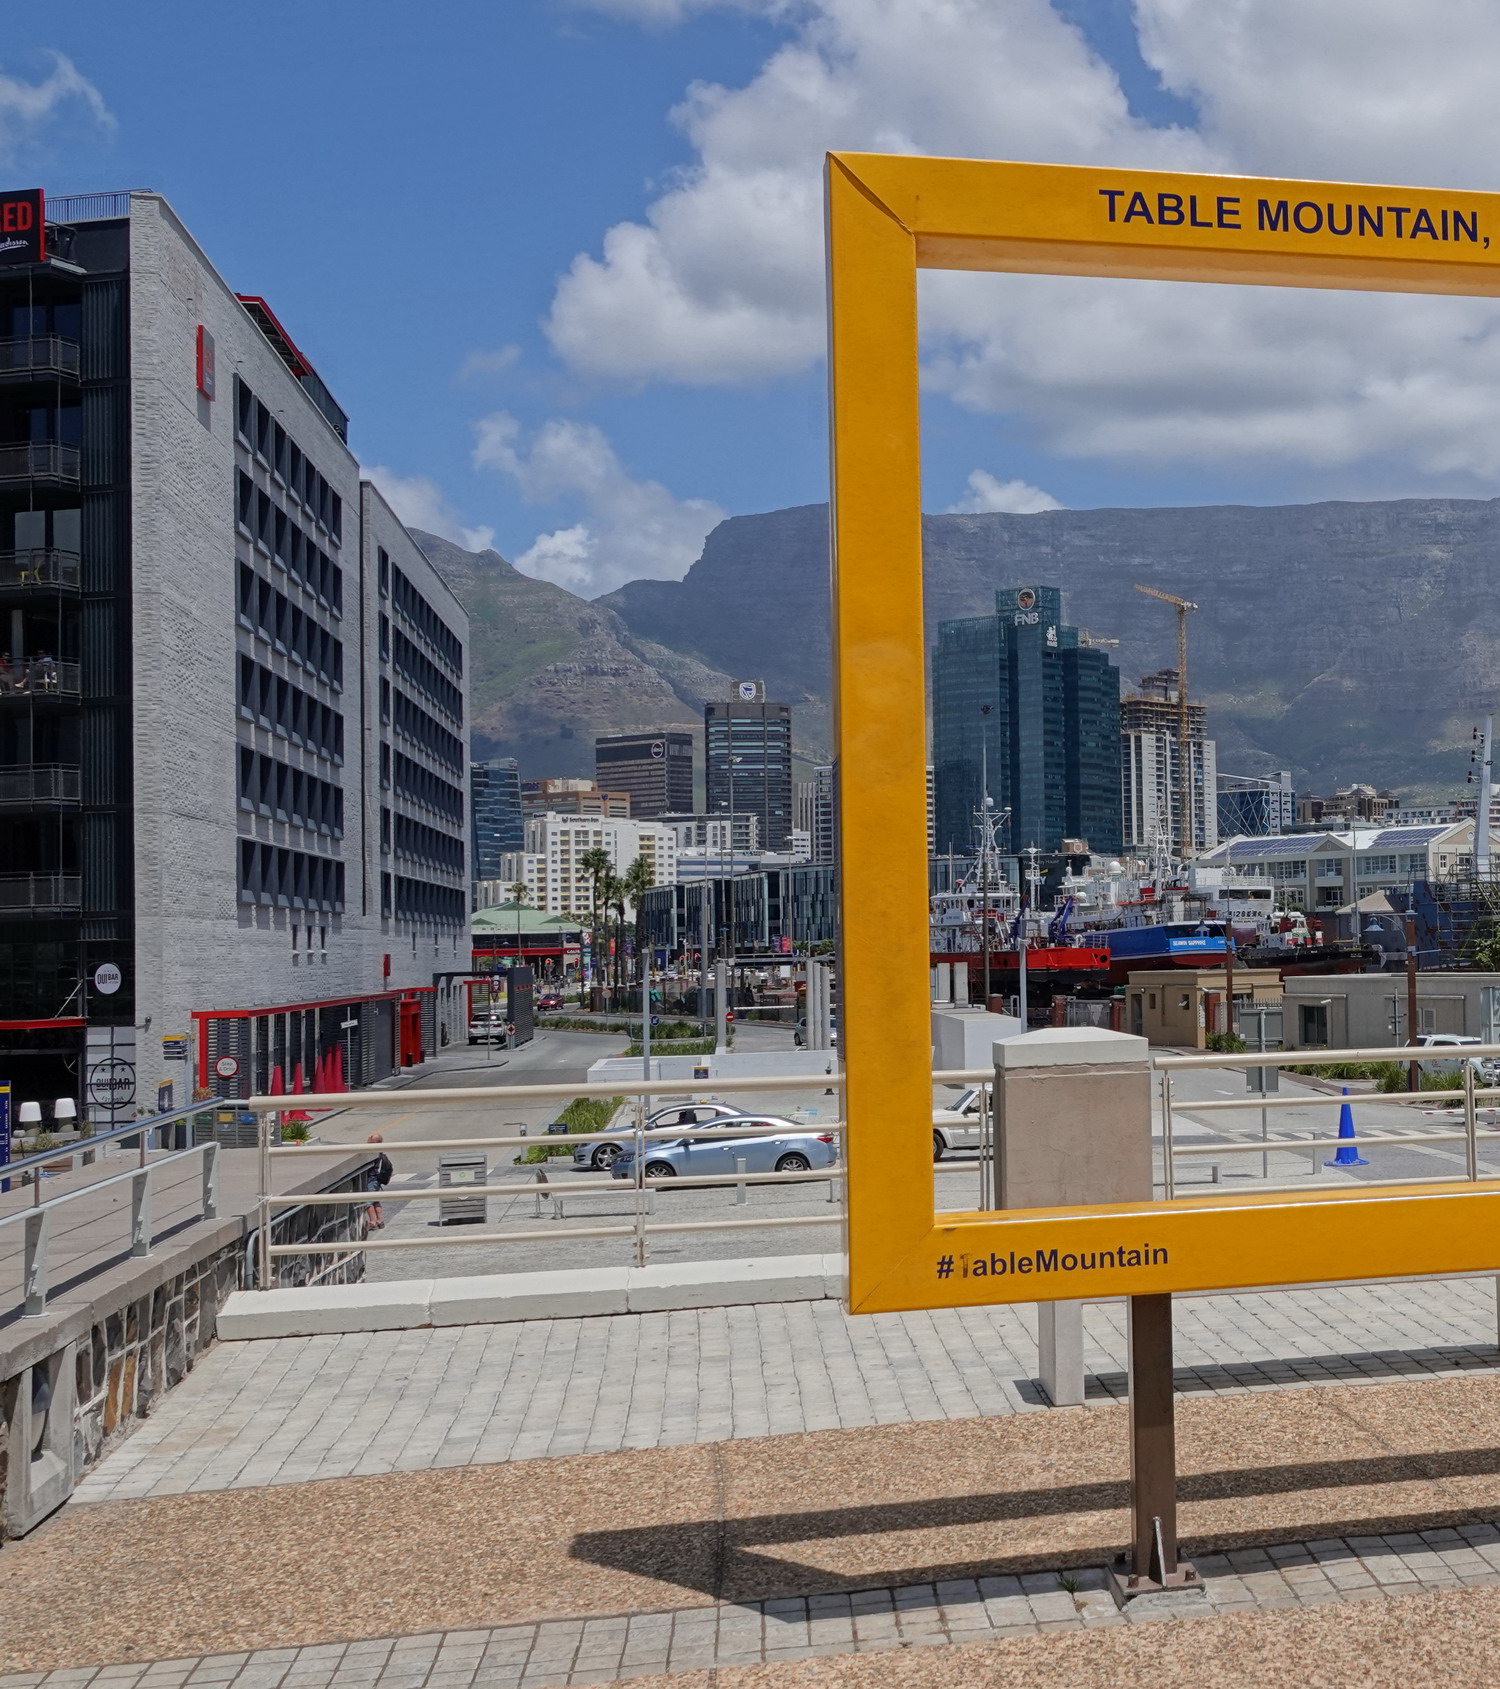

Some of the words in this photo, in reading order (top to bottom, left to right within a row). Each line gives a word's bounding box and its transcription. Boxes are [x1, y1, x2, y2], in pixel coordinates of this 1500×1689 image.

[0, 201, 33, 232] ED
[1098, 188, 1242, 231] TABLE
[1257, 199, 1491, 250] MOUNTAIN,
[0, 236, 29, 249] adisson
[1014, 612, 1039, 626] FNB
[936, 1243, 1169, 1280] #TableMountain
